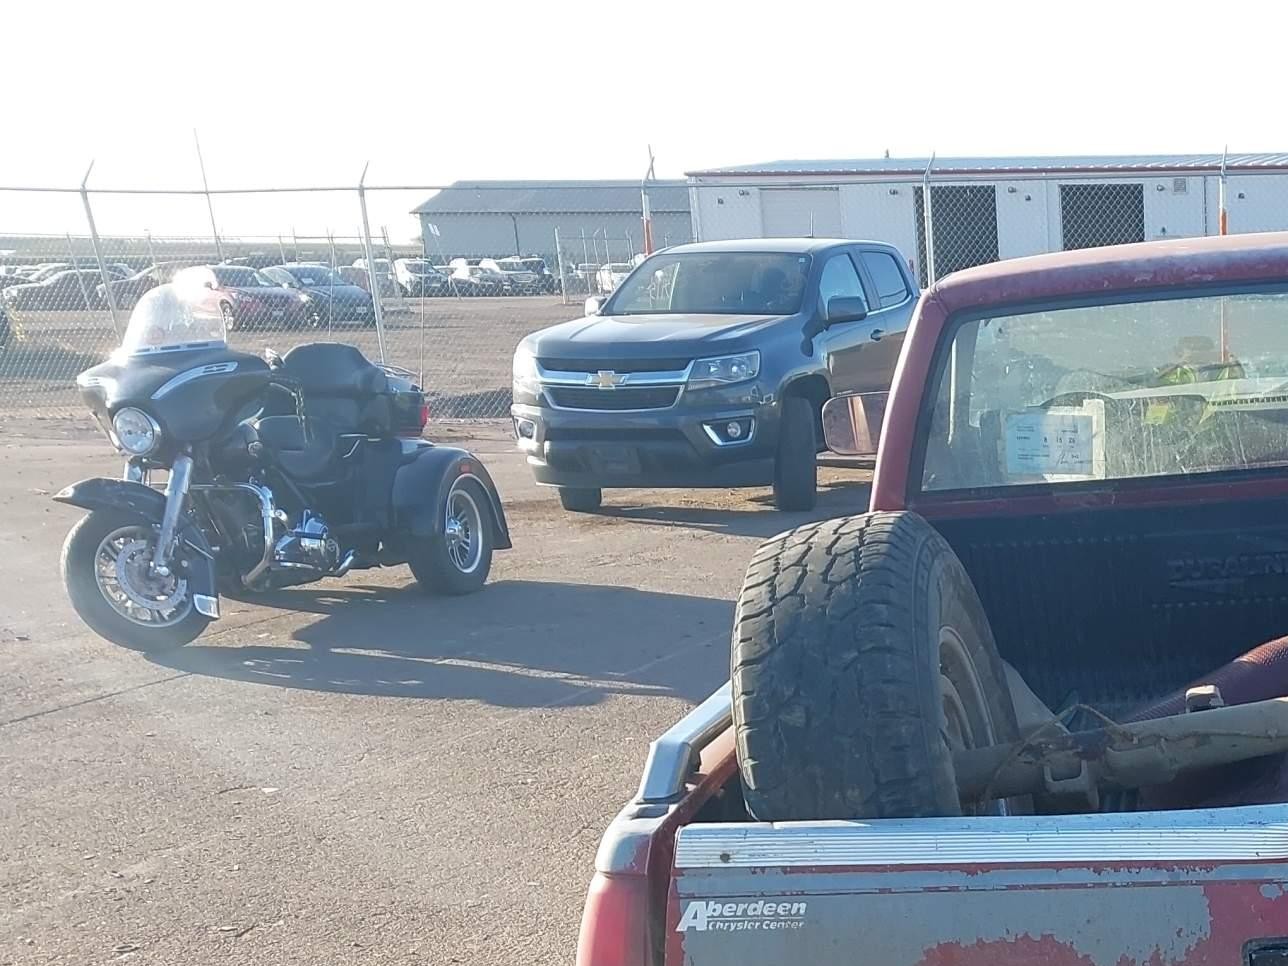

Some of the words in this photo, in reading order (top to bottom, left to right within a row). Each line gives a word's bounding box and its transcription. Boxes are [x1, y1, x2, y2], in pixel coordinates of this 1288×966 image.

[675, 900, 807, 932] Aberdeen
[708, 919, 761, 932] Chrysler
[762, 920, 804, 930] Center
